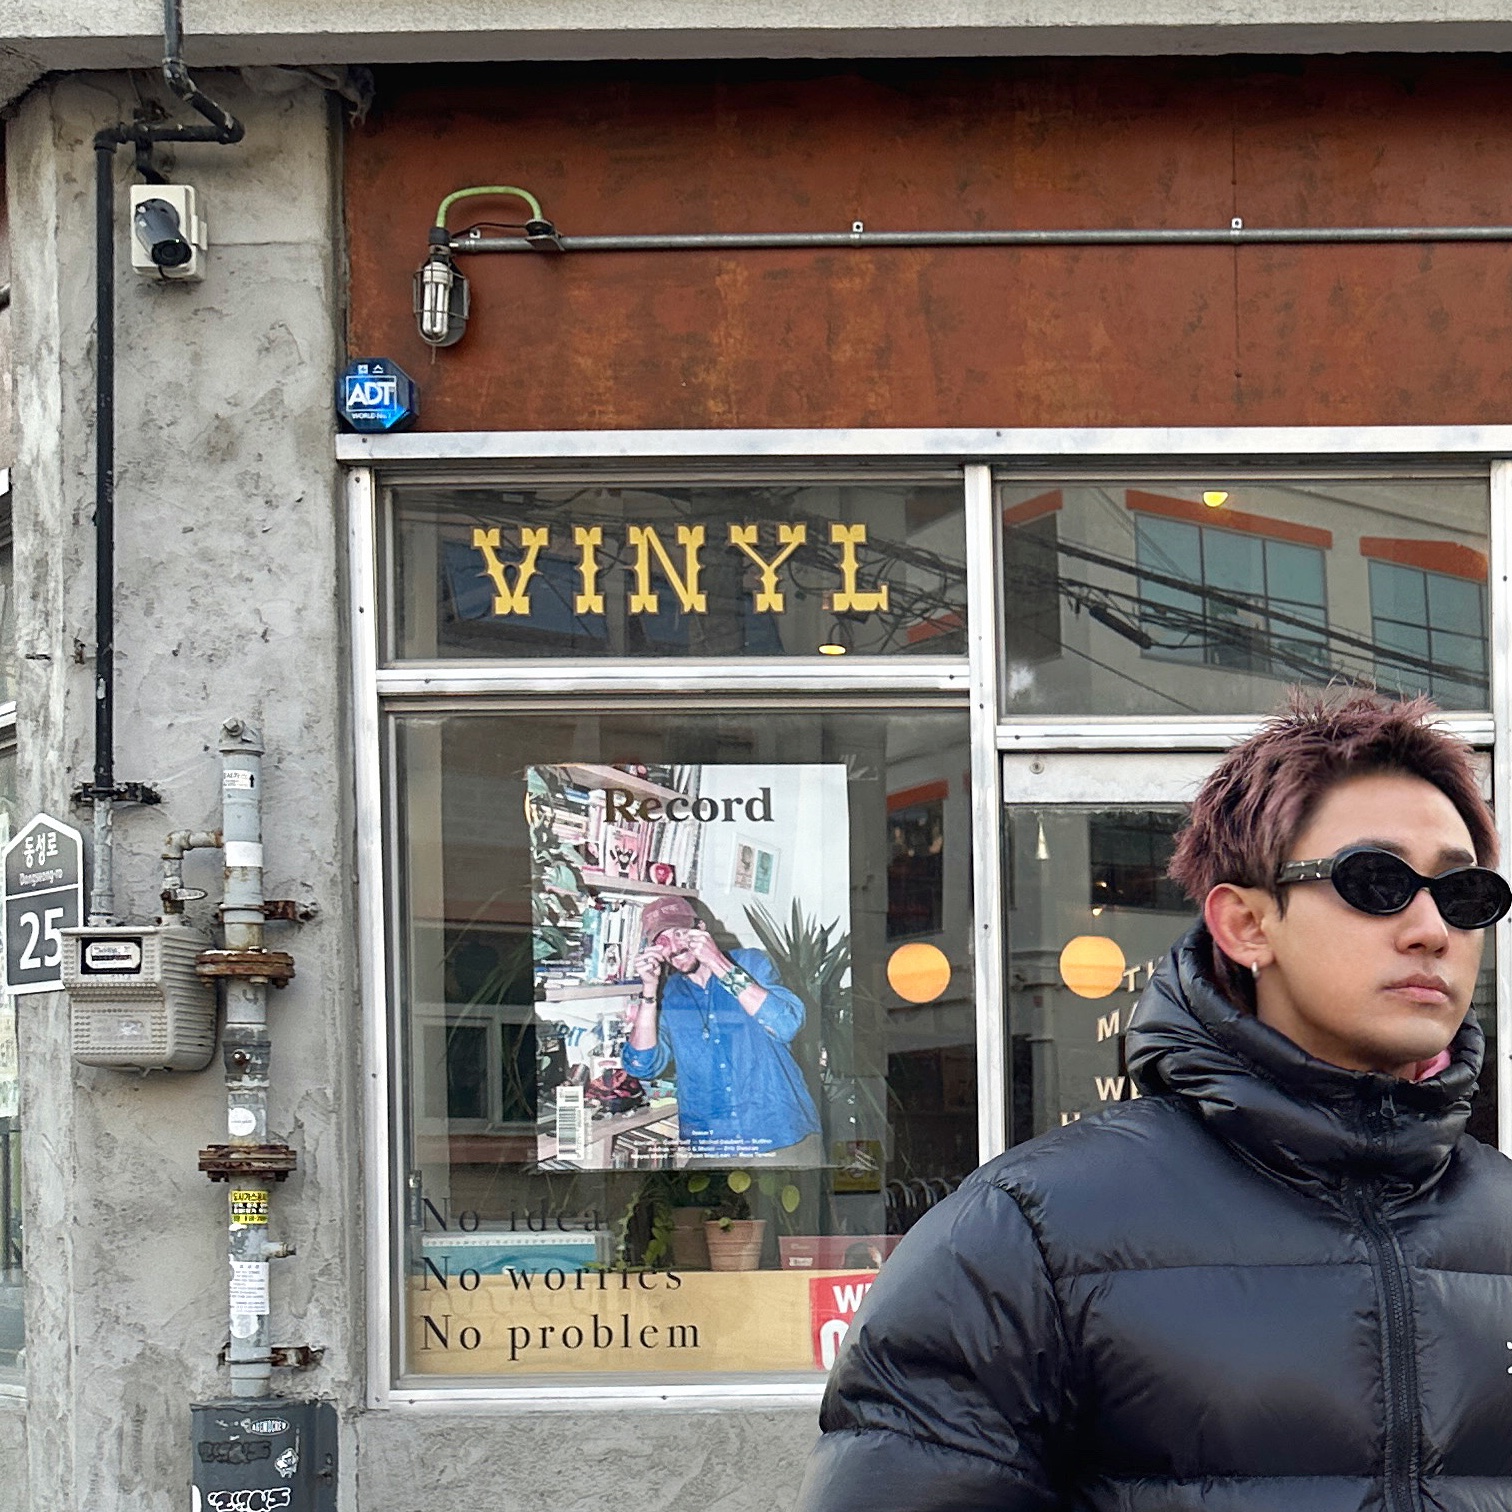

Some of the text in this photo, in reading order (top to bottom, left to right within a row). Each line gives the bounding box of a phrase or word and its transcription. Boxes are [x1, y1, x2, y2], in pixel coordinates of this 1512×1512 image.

[347, 381, 396, 406] ADT
[472, 522, 890, 617] VINYL
[602, 785, 776, 824] Record
[23, 832, 59, 869] 동성로
[19, 907, 64, 970] 25
[420, 1196, 604, 1233] No idea
[420, 1256, 683, 1292] No worries
[420, 1314, 701, 1362] No problem
